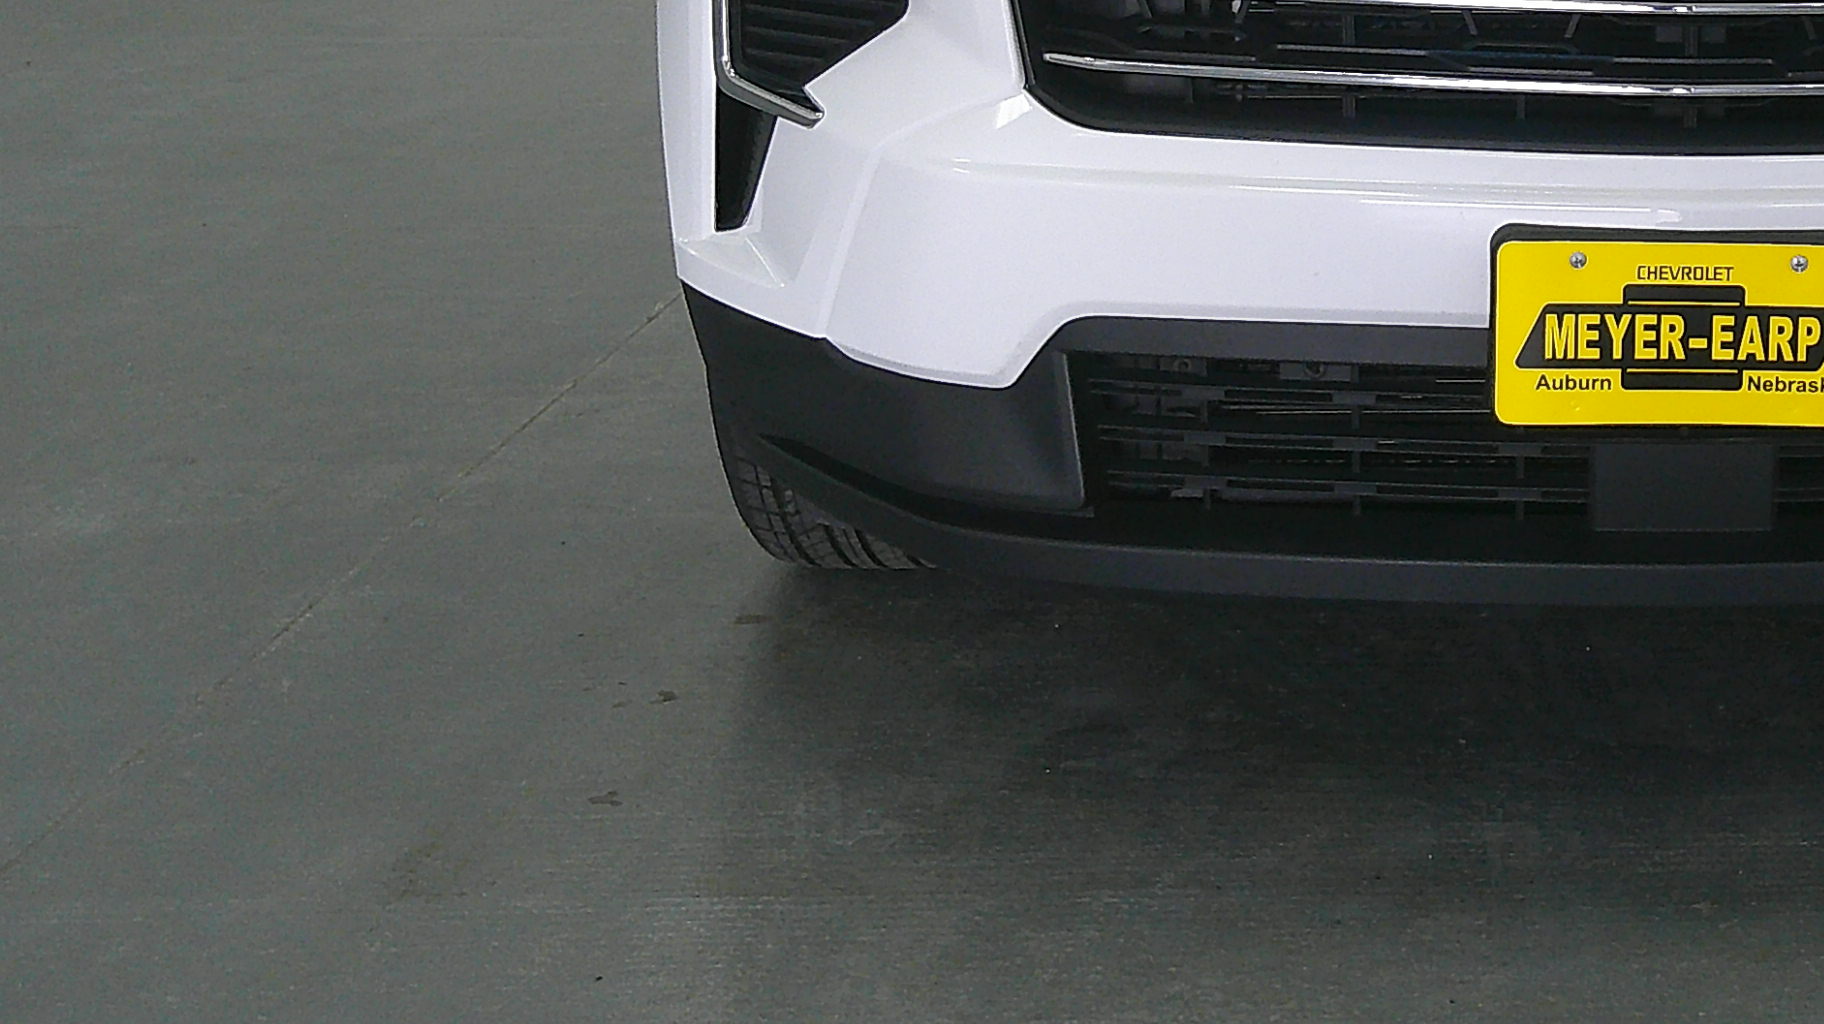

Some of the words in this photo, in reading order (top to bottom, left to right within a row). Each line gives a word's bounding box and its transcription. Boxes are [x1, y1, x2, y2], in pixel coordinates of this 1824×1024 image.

[1636, 265, 1735, 282] CHEVROLET
[1544, 313, 1822, 363] MEYER-EARP
[1535, 375, 1612, 391] Auburn
